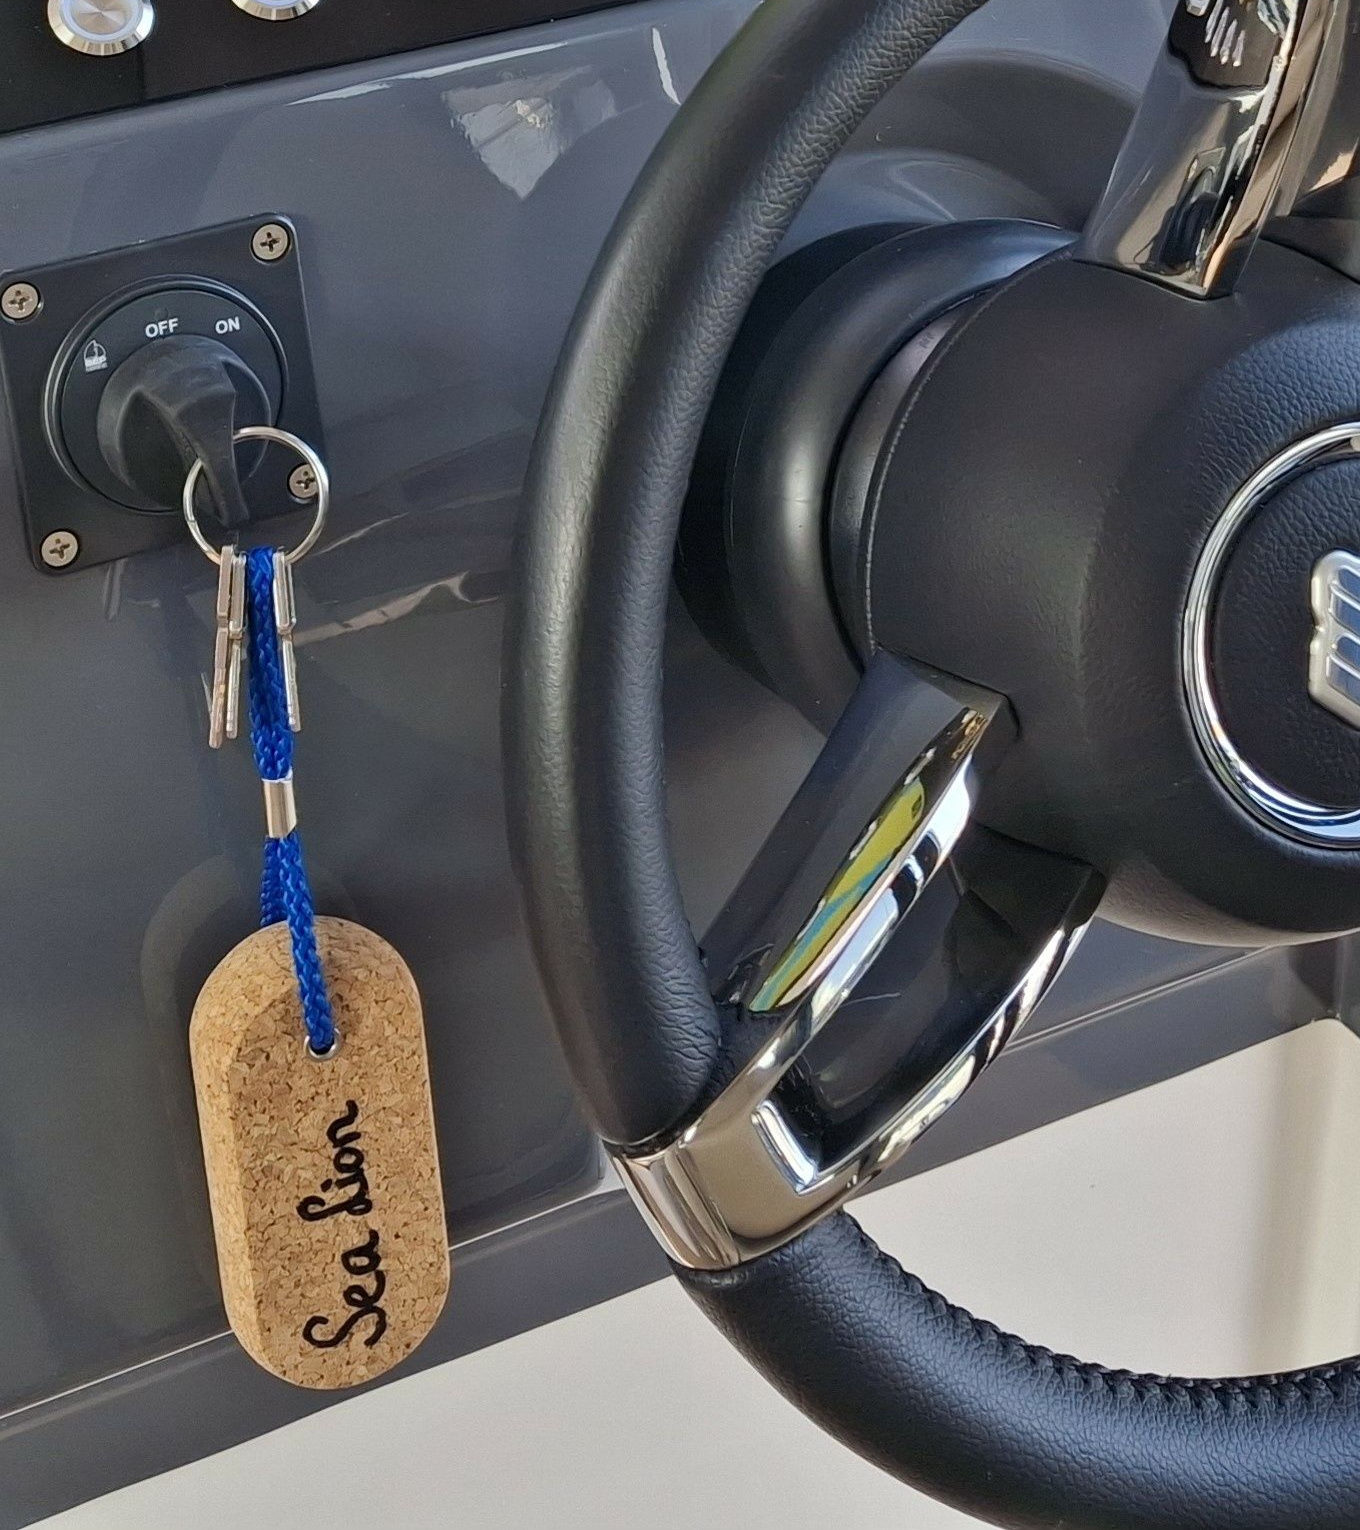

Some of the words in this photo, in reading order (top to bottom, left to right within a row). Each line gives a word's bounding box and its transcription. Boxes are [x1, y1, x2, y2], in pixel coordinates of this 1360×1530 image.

[144, 317, 180, 340] OFF
[214, 316, 242, 336] ON
[302, 1228, 389, 1350] Sea
